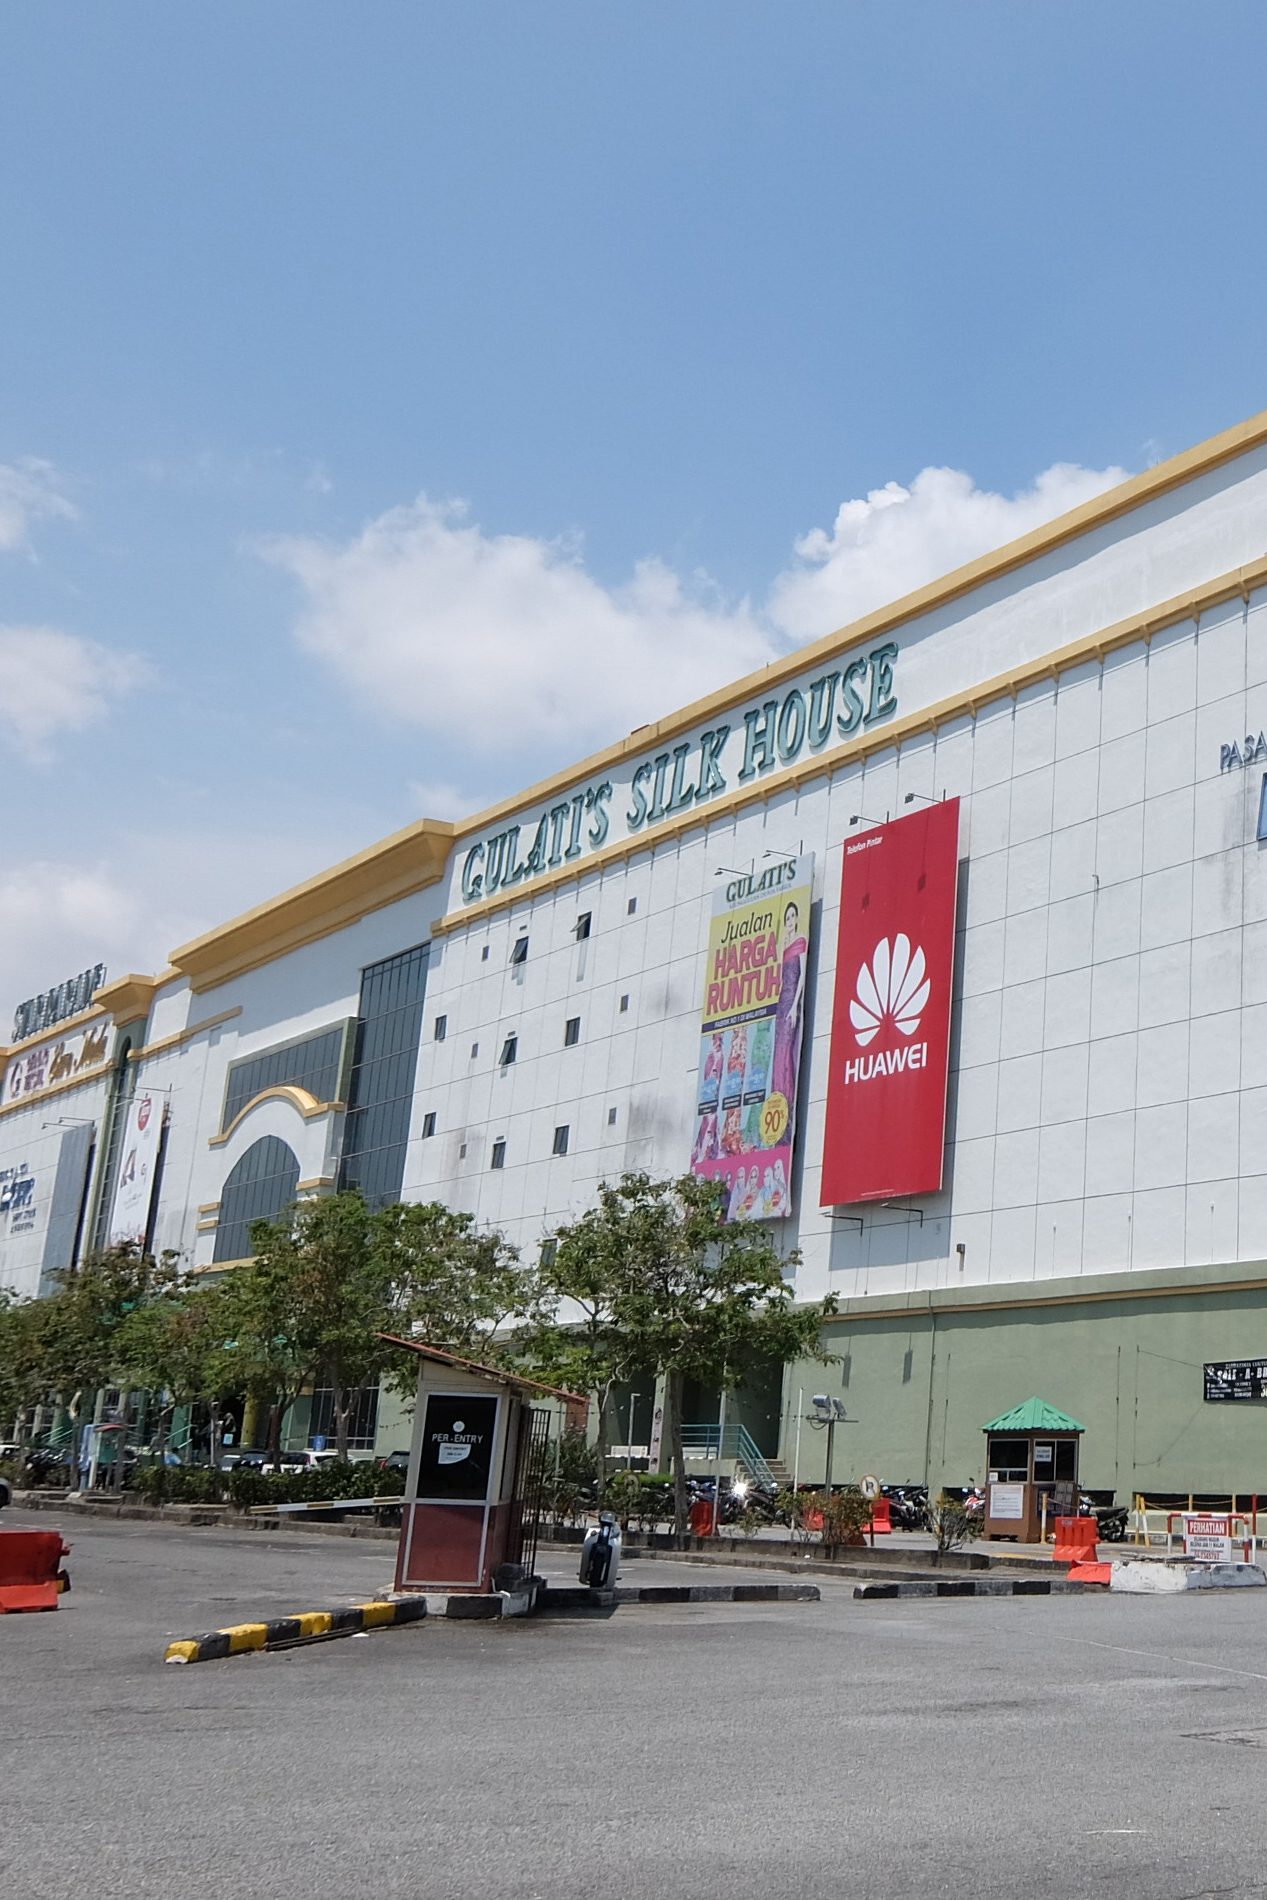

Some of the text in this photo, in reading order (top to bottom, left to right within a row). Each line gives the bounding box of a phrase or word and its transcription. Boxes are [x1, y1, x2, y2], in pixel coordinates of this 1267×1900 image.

[461, 641, 899, 901] GULATI'S SILK HOUSE
[726, 859, 797, 902] GULATI'S
[721, 912, 773, 943] Jualan
[714, 931, 777, 980] HARGA
[706, 963, 781, 1016] RUNTUH
[844, 1042, 928, 1085] HUAWEI
[1190, 1521, 1225, 1534] PERHATIAN
